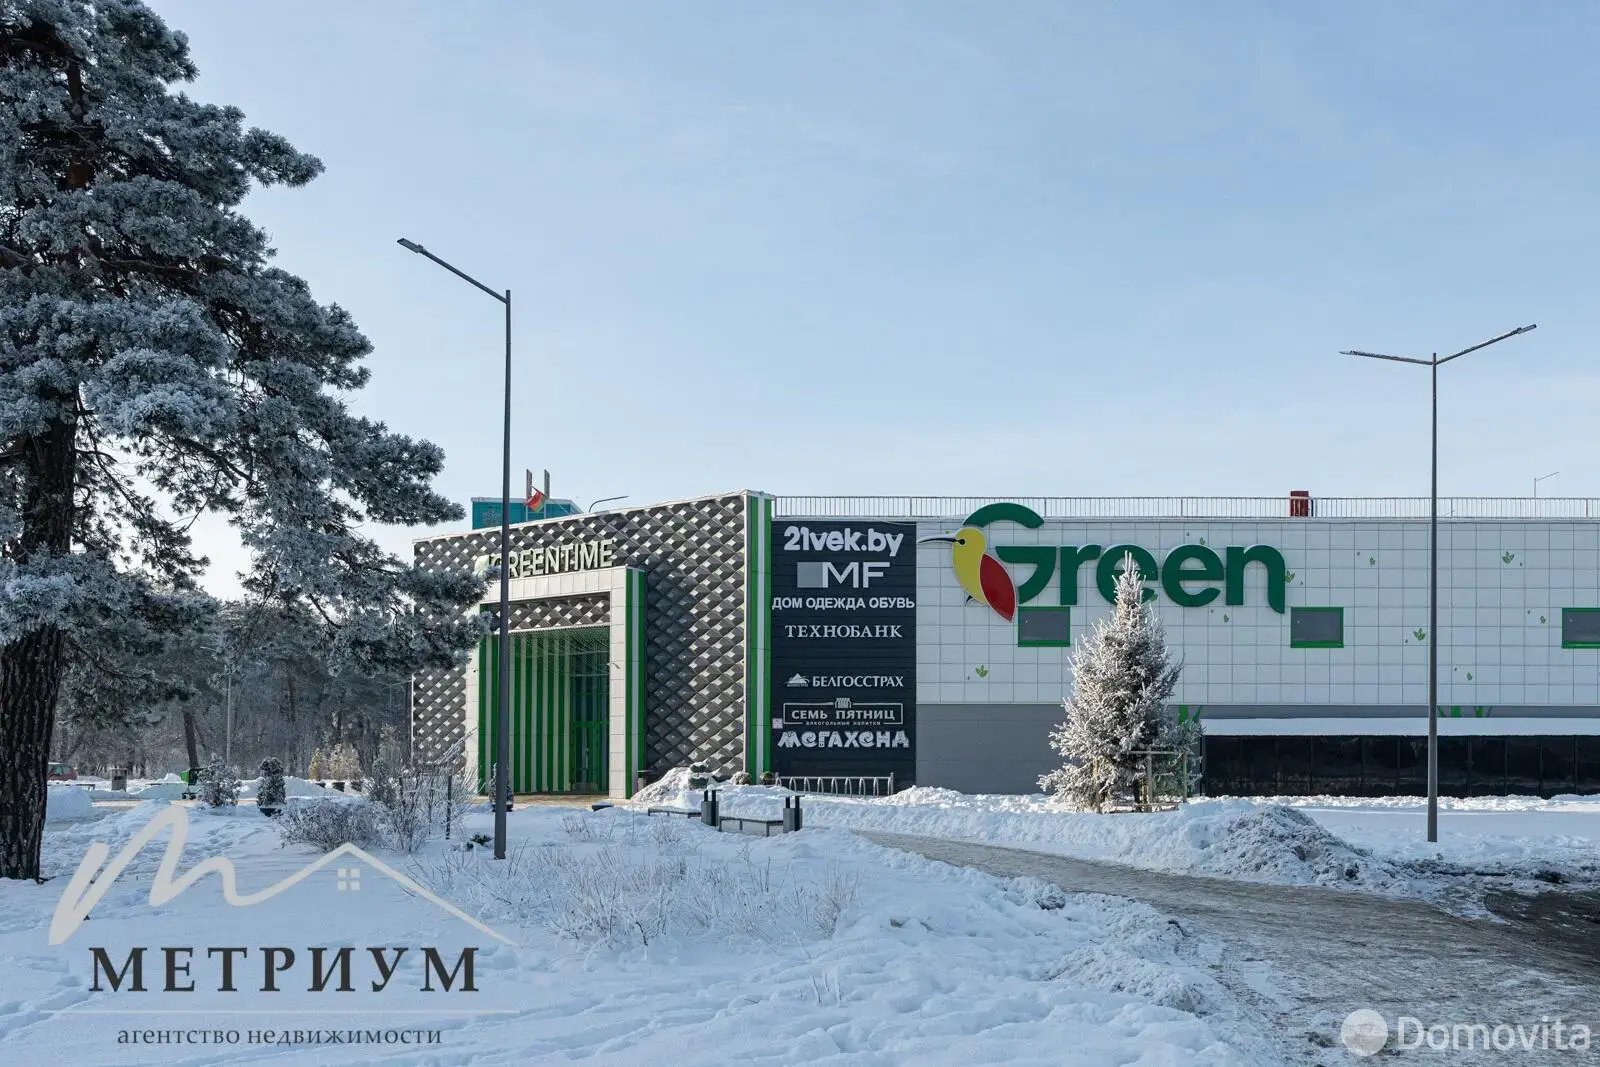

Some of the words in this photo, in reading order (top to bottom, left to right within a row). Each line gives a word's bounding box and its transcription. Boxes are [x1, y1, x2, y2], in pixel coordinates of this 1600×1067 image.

[783, 525, 904, 557] 21vek.by
[962, 502, 1286, 614] Green
[822, 561, 890, 588] MF
[771, 597, 803, 610] ДОМ
[806, 597, 866, 610] ОДЕЖДА
[869, 597, 915, 610] ОБУВЬ
[784, 624, 903, 638] ТЕХНОБАНК
[812, 675, 904, 687] БЕЛГОССТРАХ
[791, 709, 828, 720] СЕМЬ
[835, 709, 895, 721] ПЯТНИЦ
